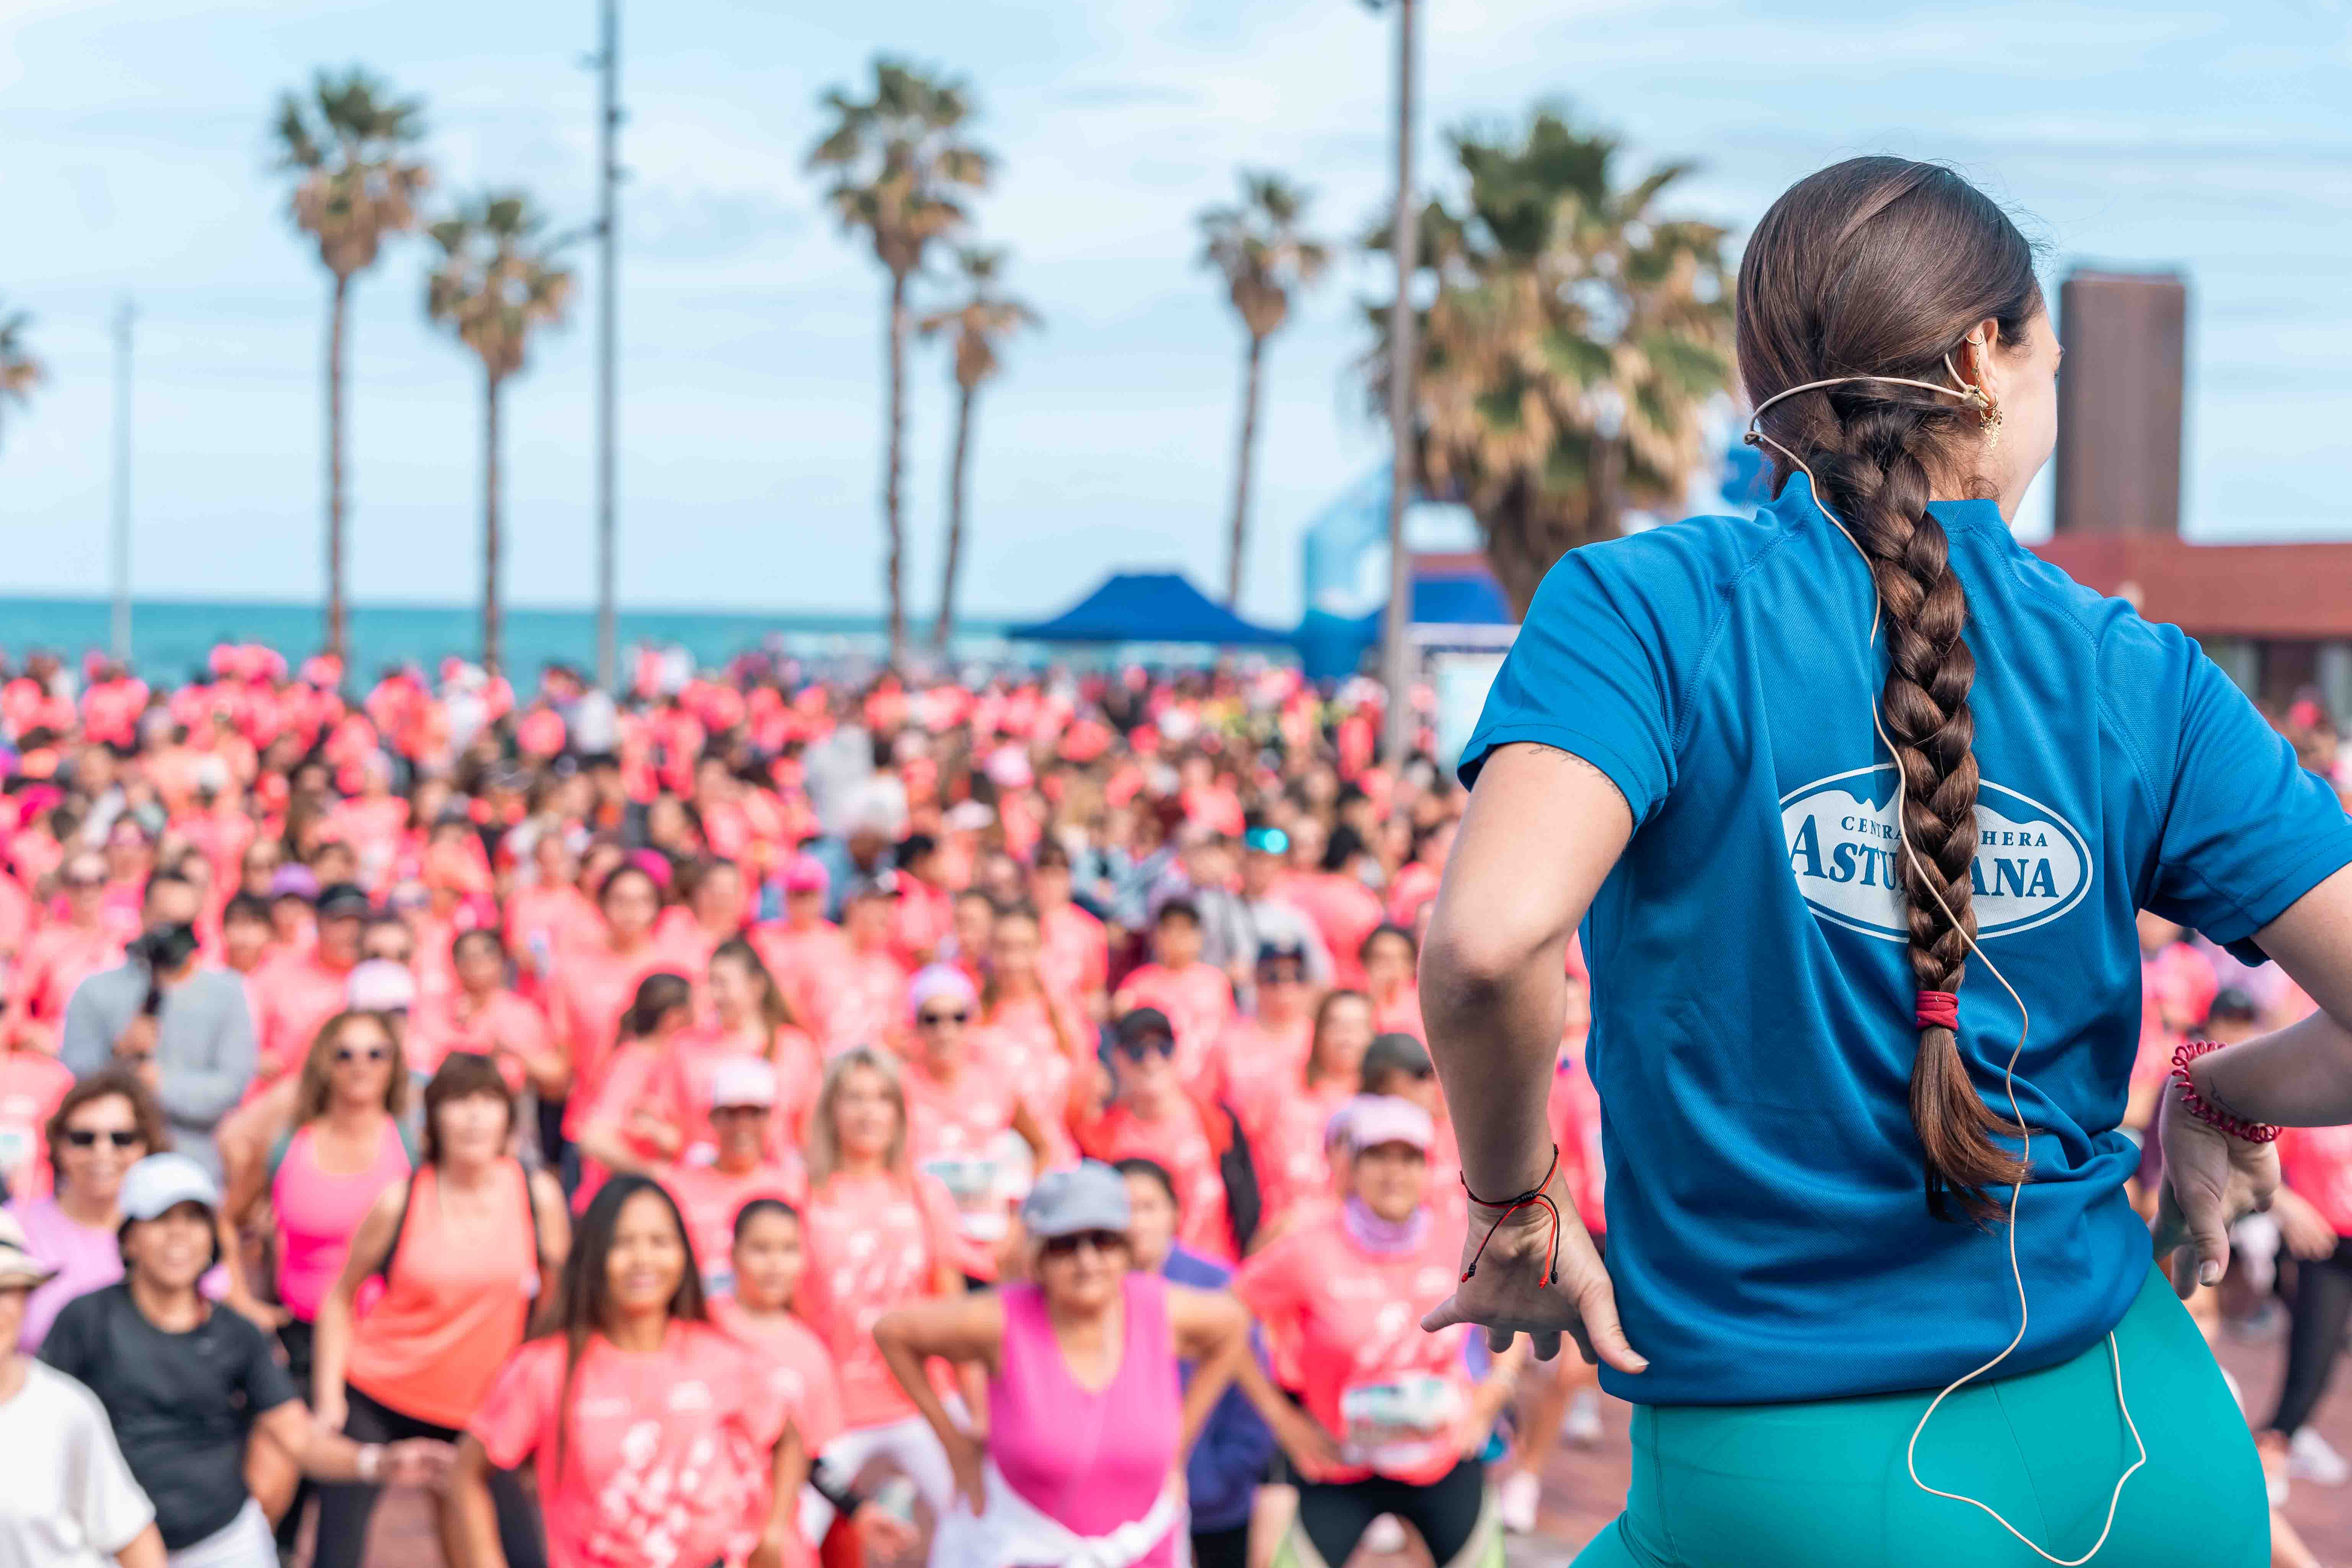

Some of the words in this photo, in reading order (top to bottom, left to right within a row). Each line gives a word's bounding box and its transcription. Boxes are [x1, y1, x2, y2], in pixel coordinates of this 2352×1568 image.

[1788, 814, 2060, 898] ASTUANA
[1841, 816, 1903, 840] CENTRA
[1981, 830, 2048, 847] HERA
